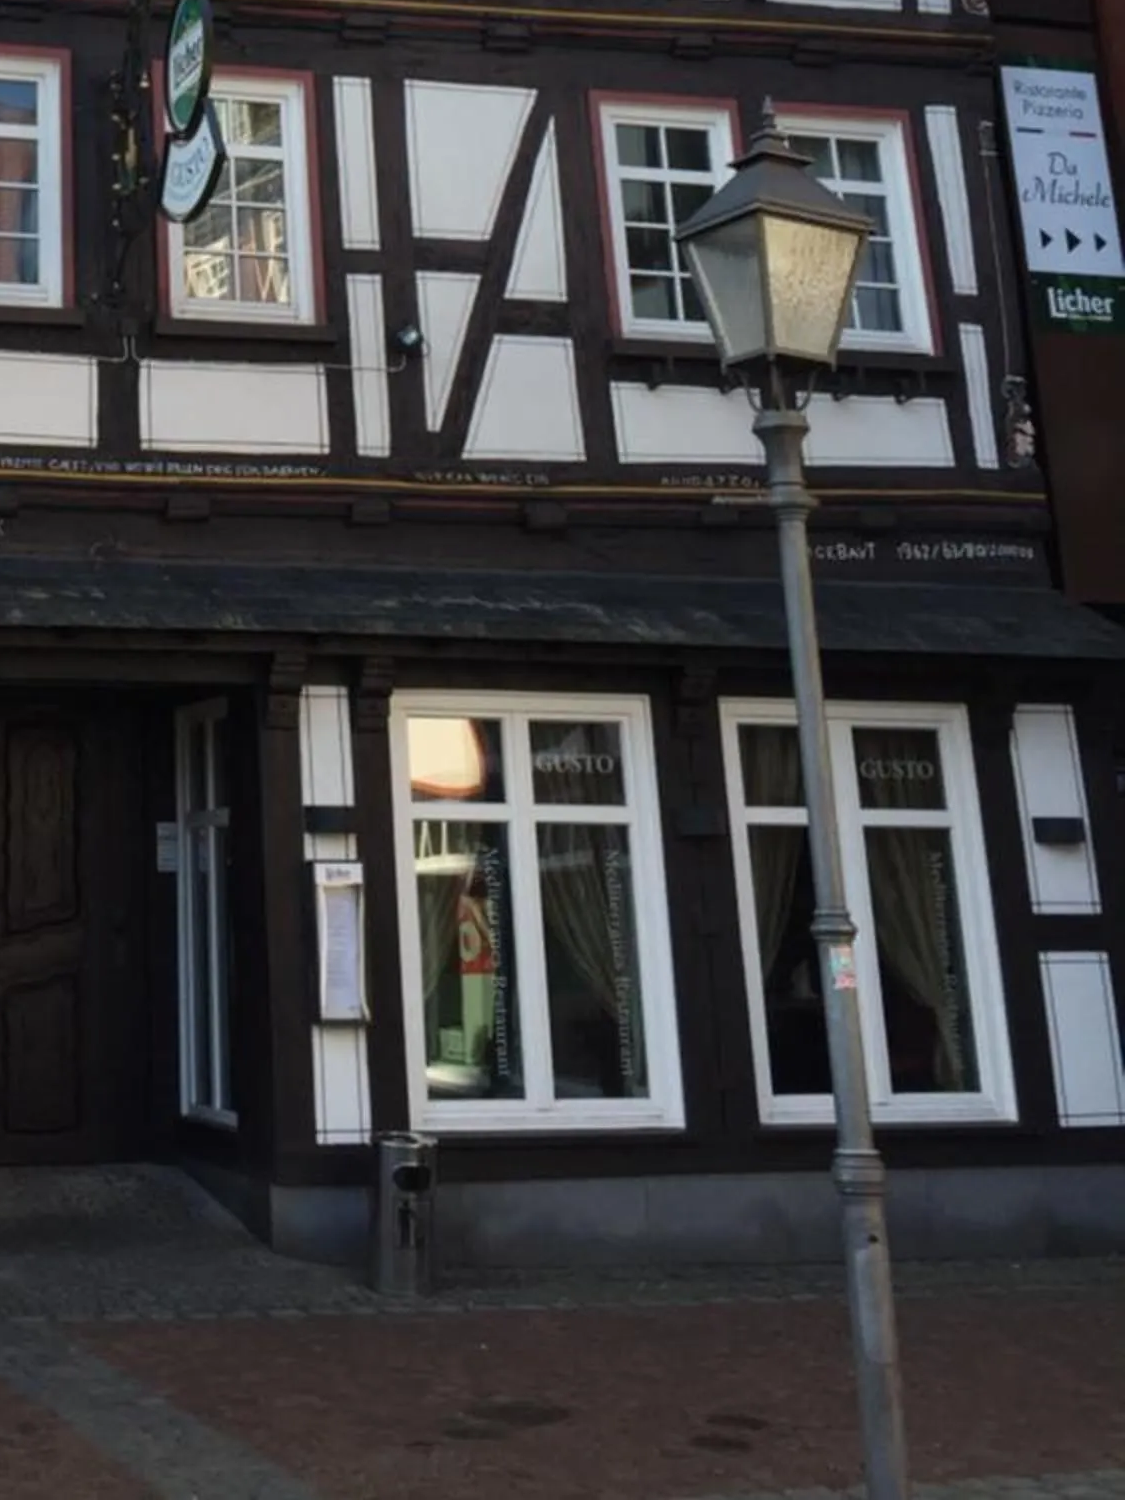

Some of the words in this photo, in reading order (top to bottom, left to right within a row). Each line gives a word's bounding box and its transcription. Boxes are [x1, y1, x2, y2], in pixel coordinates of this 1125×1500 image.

[1014, 80, 1087, 101] Ristorante
[1021, 99, 1083, 119] Pizzeria
[1047, 151, 1078, 175] Da
[1023, 176, 1111, 208] Michele
[1047, 286, 1115, 319] Licher
[535, 753, 615, 774] GUSTO
[860, 758, 935, 779] GUSTO
[491, 975, 511, 1077] Restaurant
